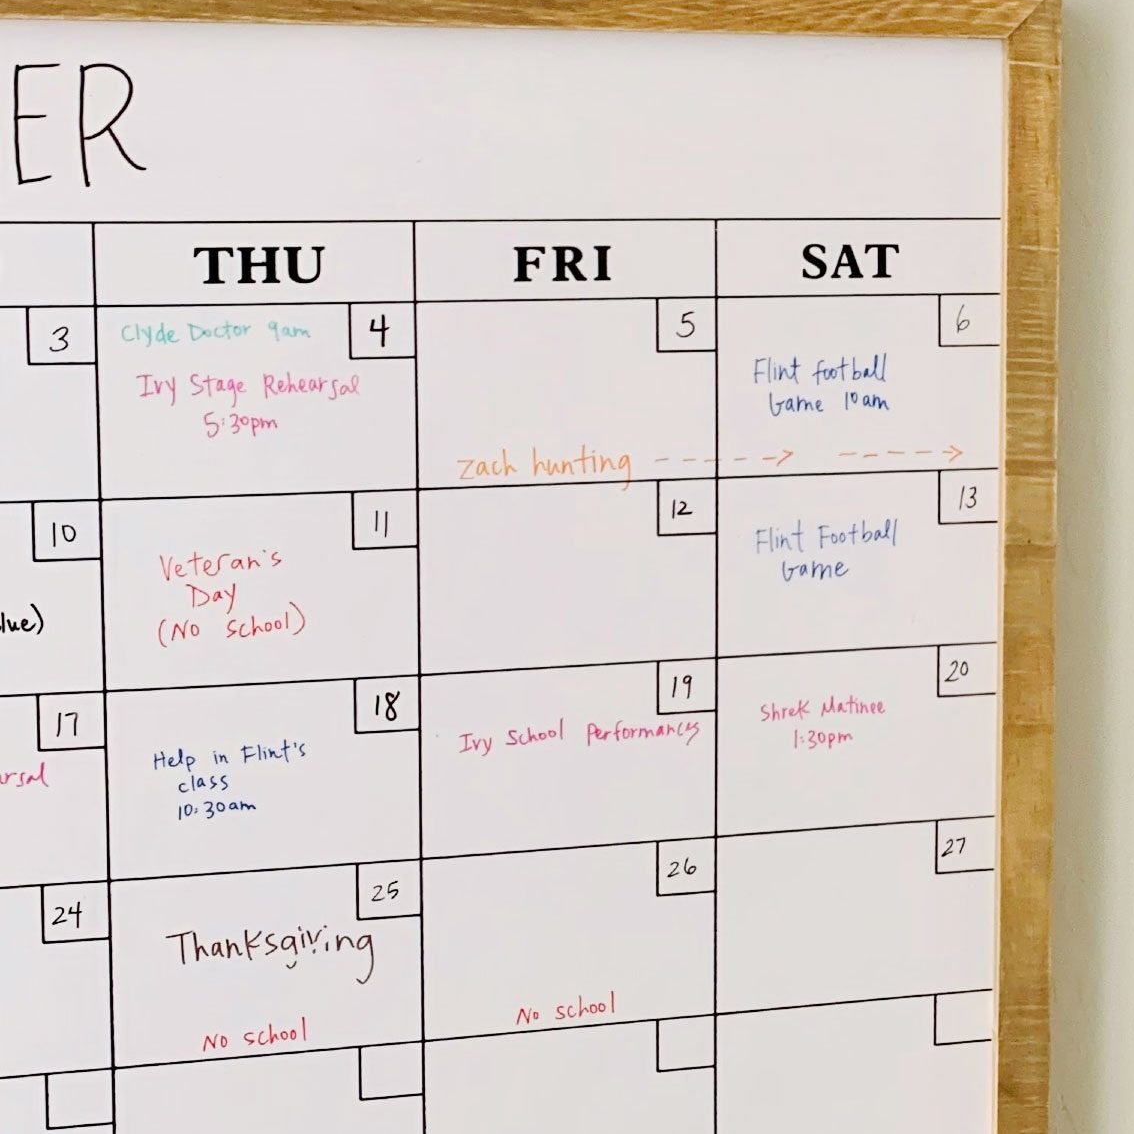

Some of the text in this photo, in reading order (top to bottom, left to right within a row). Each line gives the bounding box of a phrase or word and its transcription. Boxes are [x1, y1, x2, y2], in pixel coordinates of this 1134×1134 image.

[194, 246, 325, 284] THU
[514, 246, 611, 282] FRI
[803, 244, 899, 279] SAT
[370, 314, 390, 347] 4
[676, 311, 695, 338] 5
[956, 304, 970, 333] 6
[49, 327, 68, 352] 3
[122, 321, 311, 347] Clyde Doctor 9am
[754, 357, 800, 384] Flint
[136, 372, 359, 408] Ivy Stage Rehearsal
[769, 392, 889, 416] Game 10am
[203, 412, 278, 438] 5:30pm
[532, 444, 632, 491] hunting
[672, 500, 693, 519] 12
[959, 486, 977, 509] 13
[53, 522, 76, 547] 10
[375, 510, 388, 538] 11
[755, 518, 897, 554] Flint Football
[160, 550, 282, 581] Veteran's
[782, 561, 848, 582] Game
[186, 583, 235, 614] Day
[158, 601, 306, 648] (No school)
[944, 660, 968, 682] 20
[672, 675, 692, 699] 19
[376, 691, 400, 721] 18
[761, 696, 885, 722] Shrek Matinee
[56, 712, 78, 737] 17
[459, 733, 492, 756] Ivy
[793, 729, 853, 750] 1:30pm
[154, 739, 306, 772] Help in Flint's
[179, 775, 228, 793] class
[179, 801, 256, 820] 10:30am
[941, 837, 965, 857] 27
[667, 858, 696, 878] 26
[371, 881, 399, 901] 25
[52, 902, 82, 928] 24
[166, 924, 375, 984] Thanksgiving
[516, 991, 614, 1025] No school
[203, 1017, 306, 1052] No school
